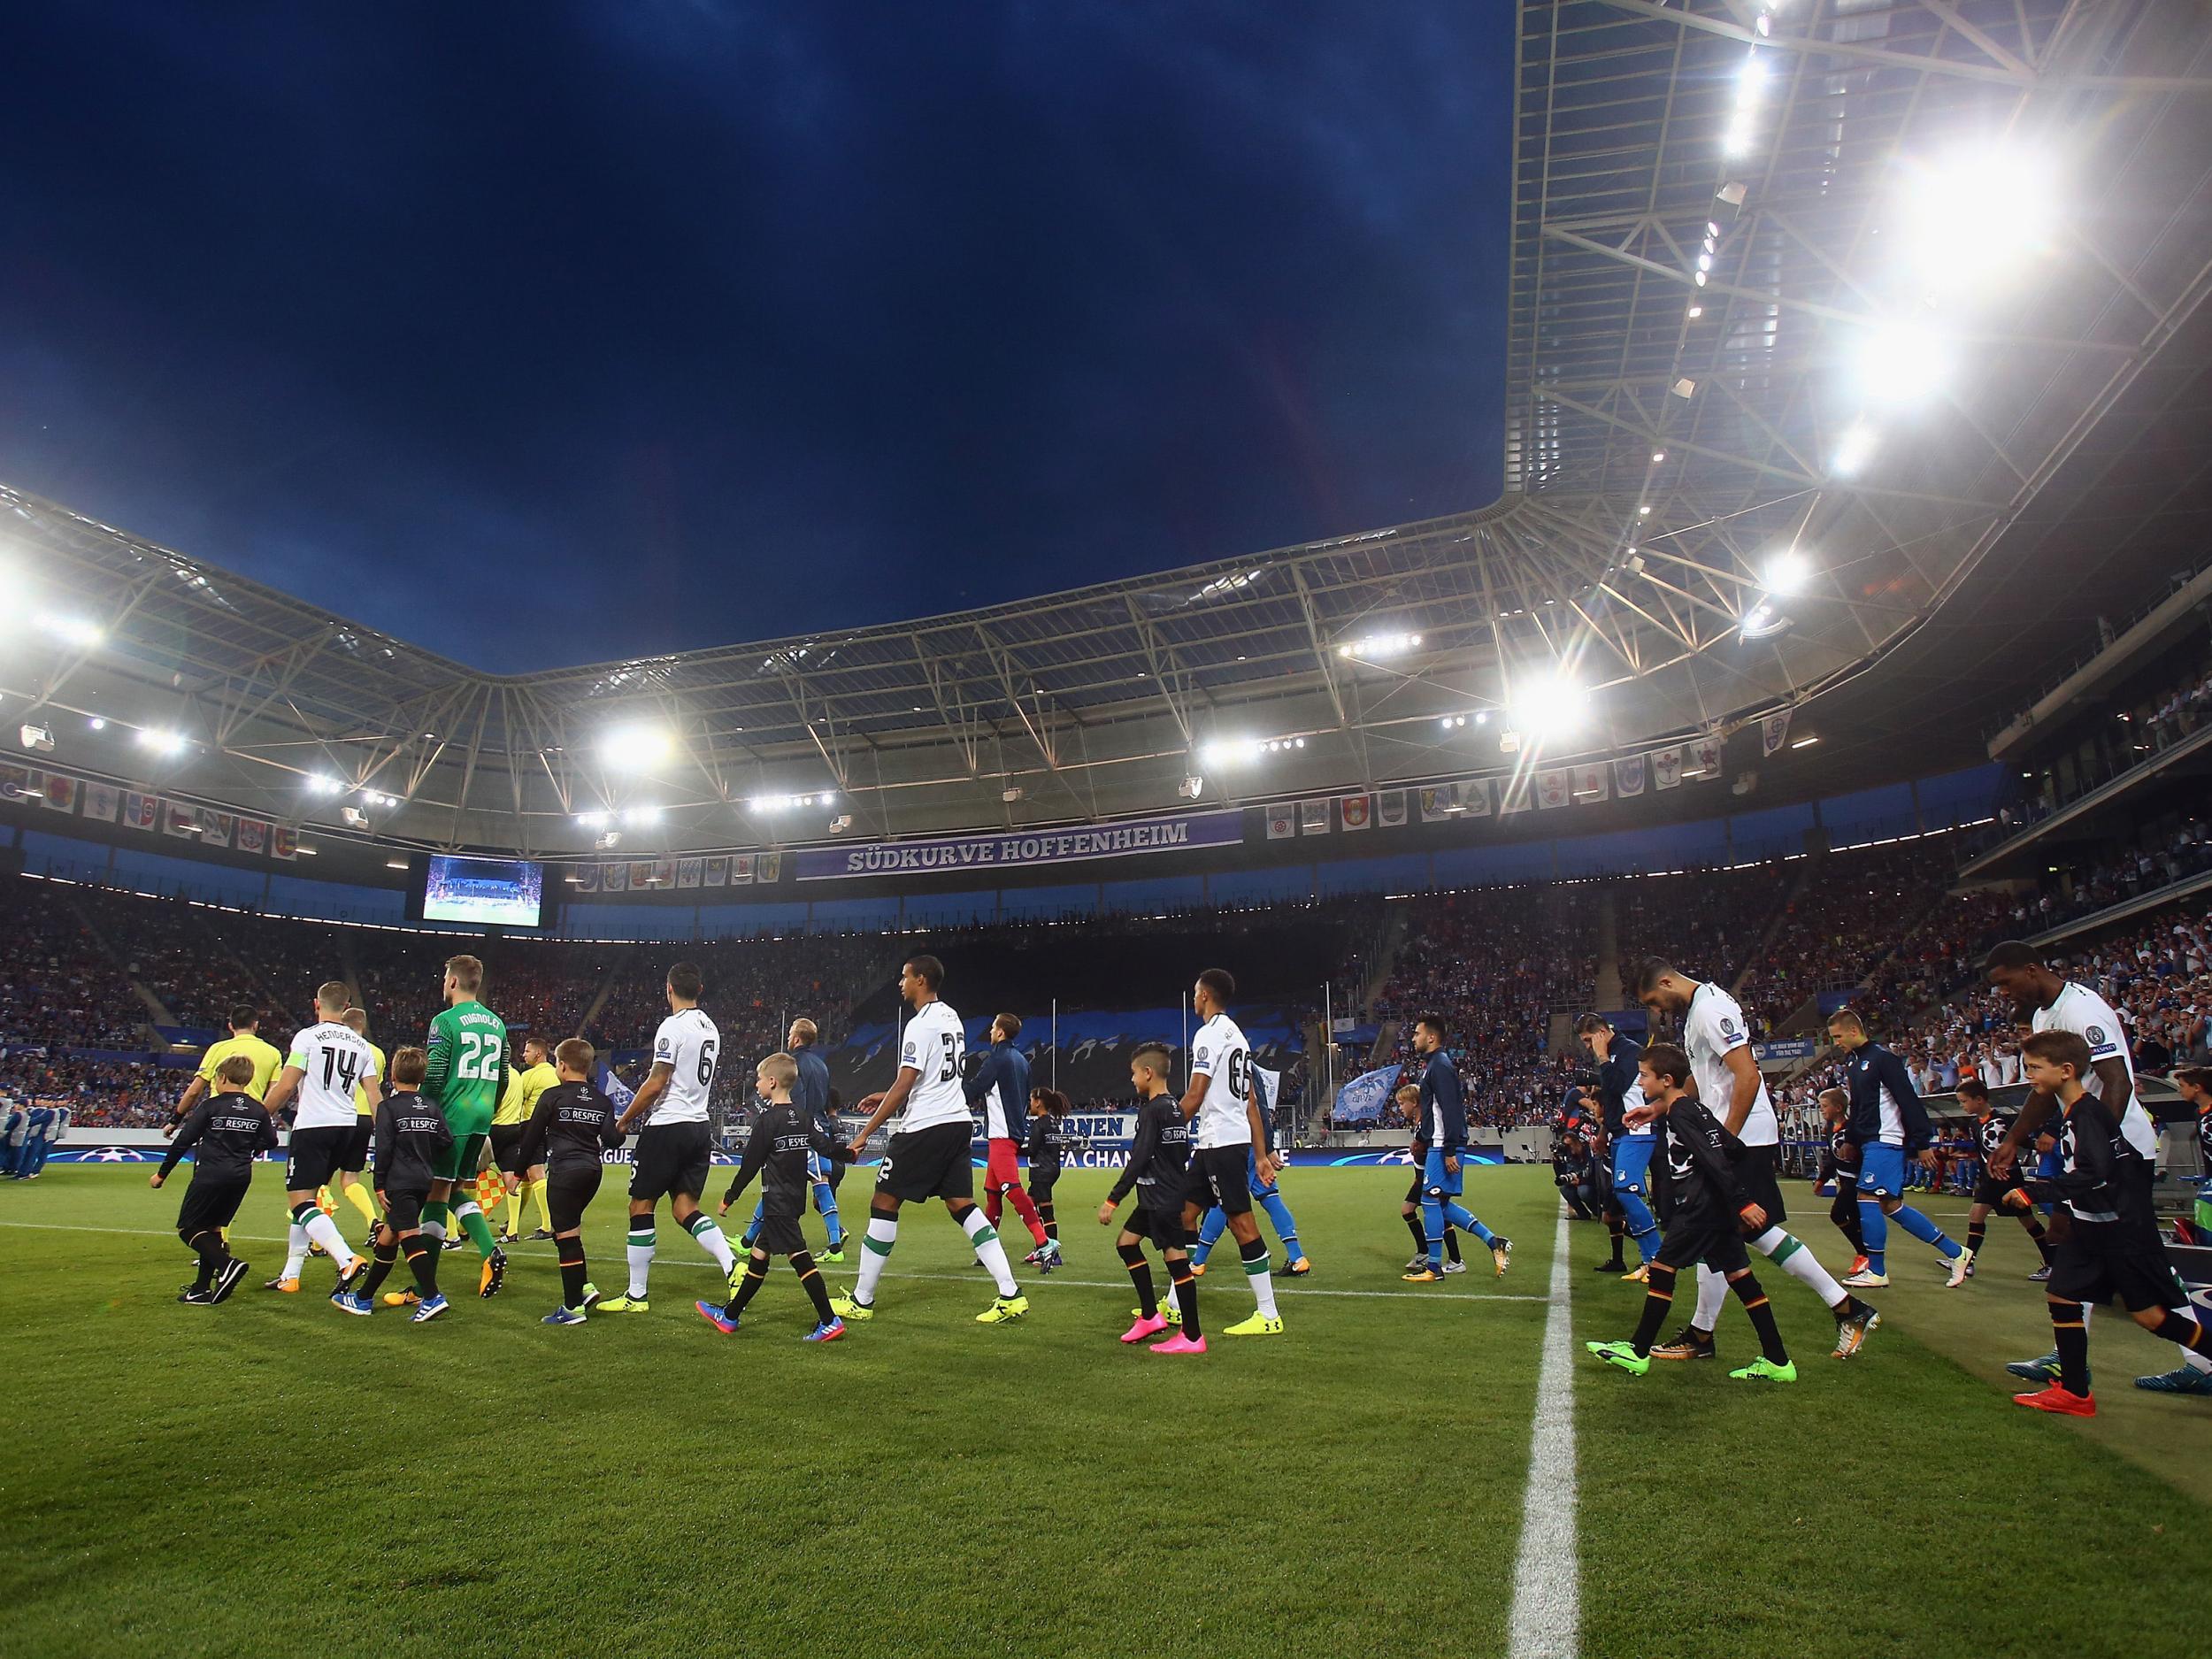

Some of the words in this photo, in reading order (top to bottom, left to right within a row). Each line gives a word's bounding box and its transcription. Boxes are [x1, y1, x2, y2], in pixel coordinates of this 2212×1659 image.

[848, 842, 995, 872] SÜDKURVE
[1001, 822, 1188, 861] HOFFENHEIM
[315, 1030, 366, 1051] HENDERSON
[457, 1032, 502, 1081] 22
[697, 1040, 715, 1087] 6
[321, 1046, 357, 1094] 14
[599, 1149, 633, 1164] GUE
